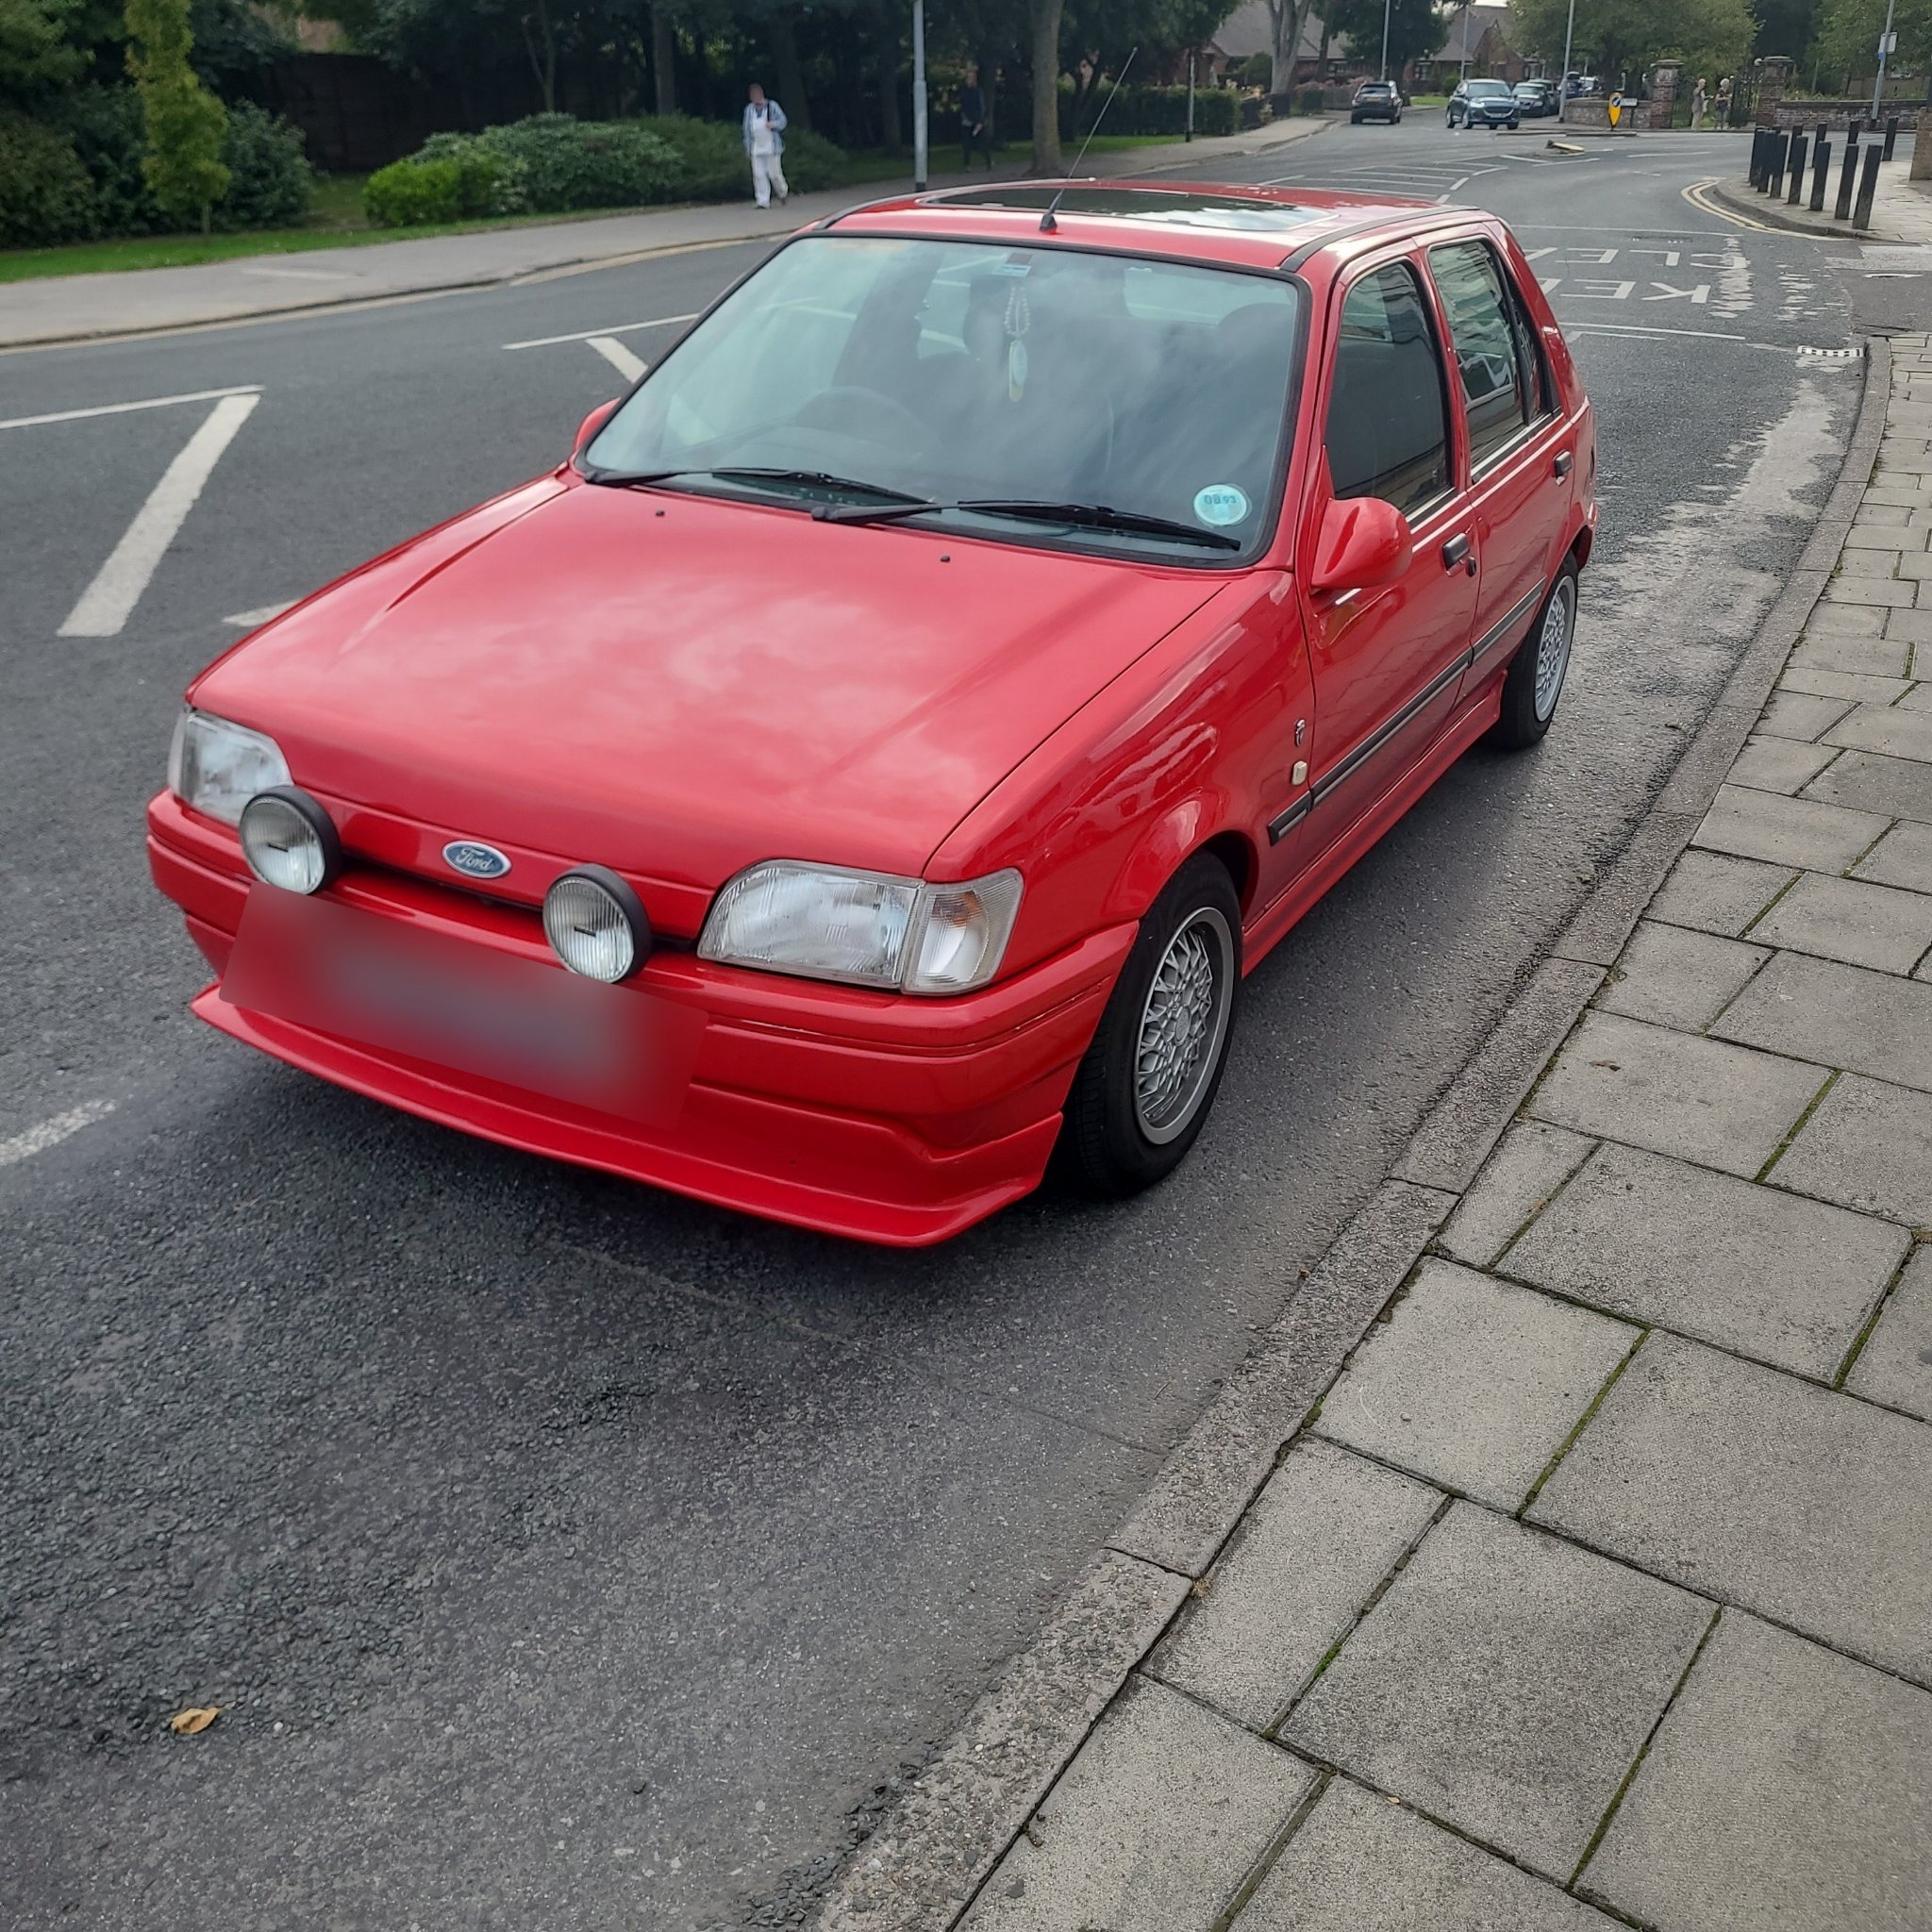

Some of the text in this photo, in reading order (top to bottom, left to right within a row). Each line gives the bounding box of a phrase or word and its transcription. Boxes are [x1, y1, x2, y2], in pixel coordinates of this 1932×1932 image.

[1524, 246, 1749, 270] CLEA
[1537, 277, 1710, 304] KE
[456, 847, 493, 872] Ford
